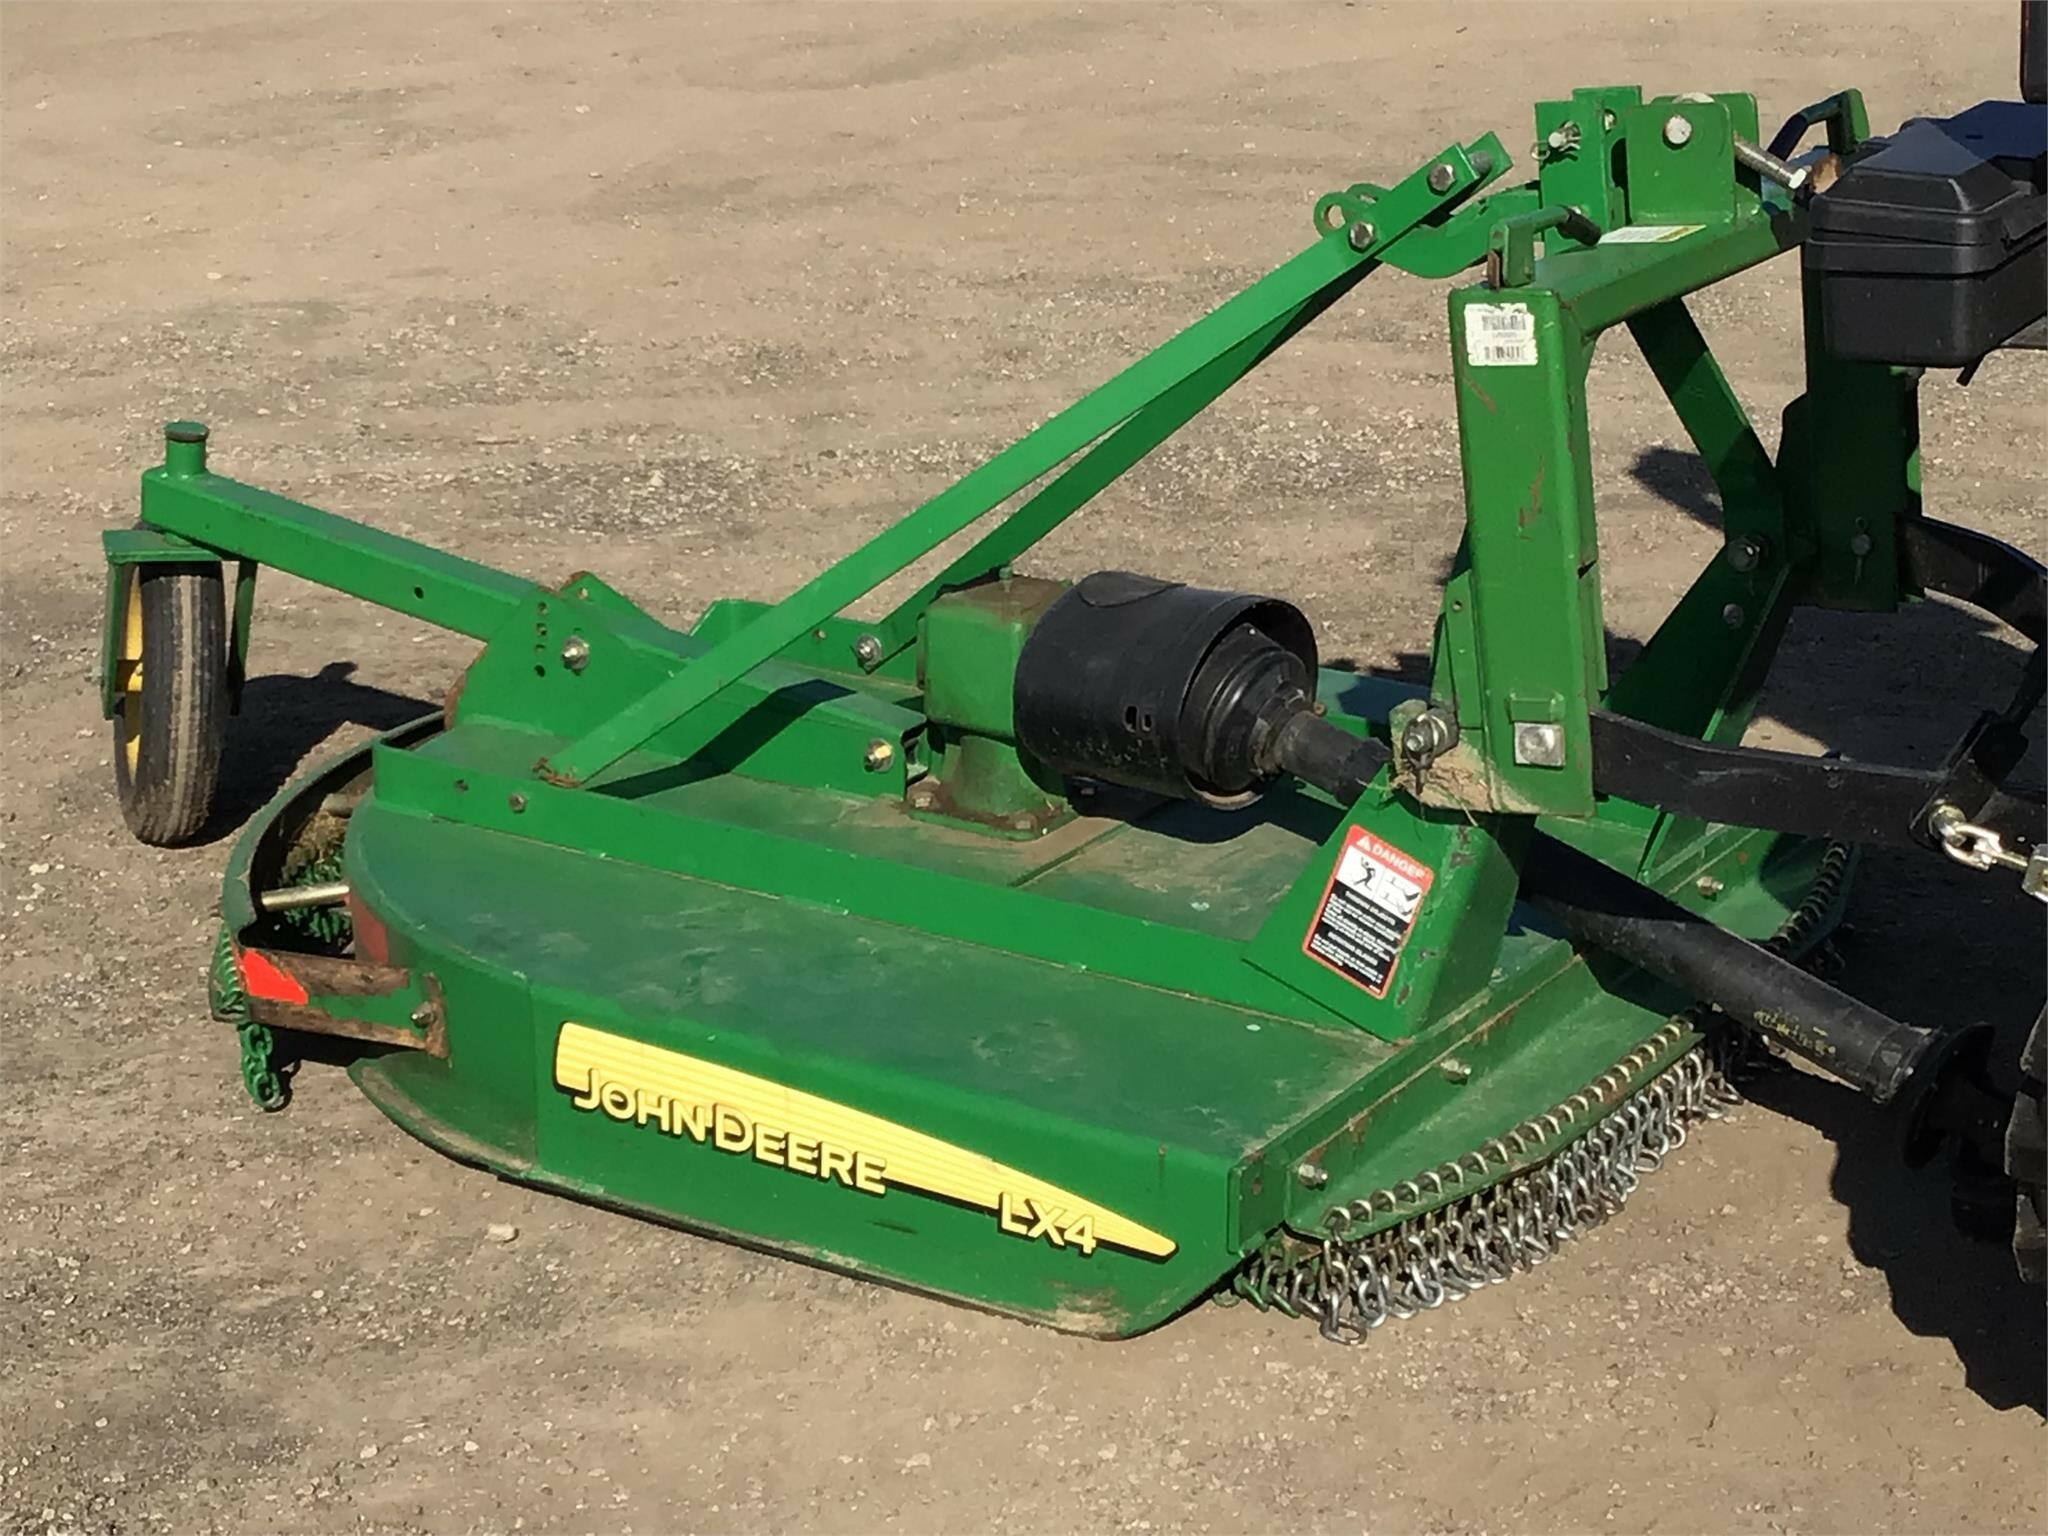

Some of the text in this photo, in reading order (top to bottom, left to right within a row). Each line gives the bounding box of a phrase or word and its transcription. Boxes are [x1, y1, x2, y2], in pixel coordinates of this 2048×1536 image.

[1372, 845, 1425, 880] DANGER
[574, 1068, 1098, 1254] JOHN DEERE LX4
